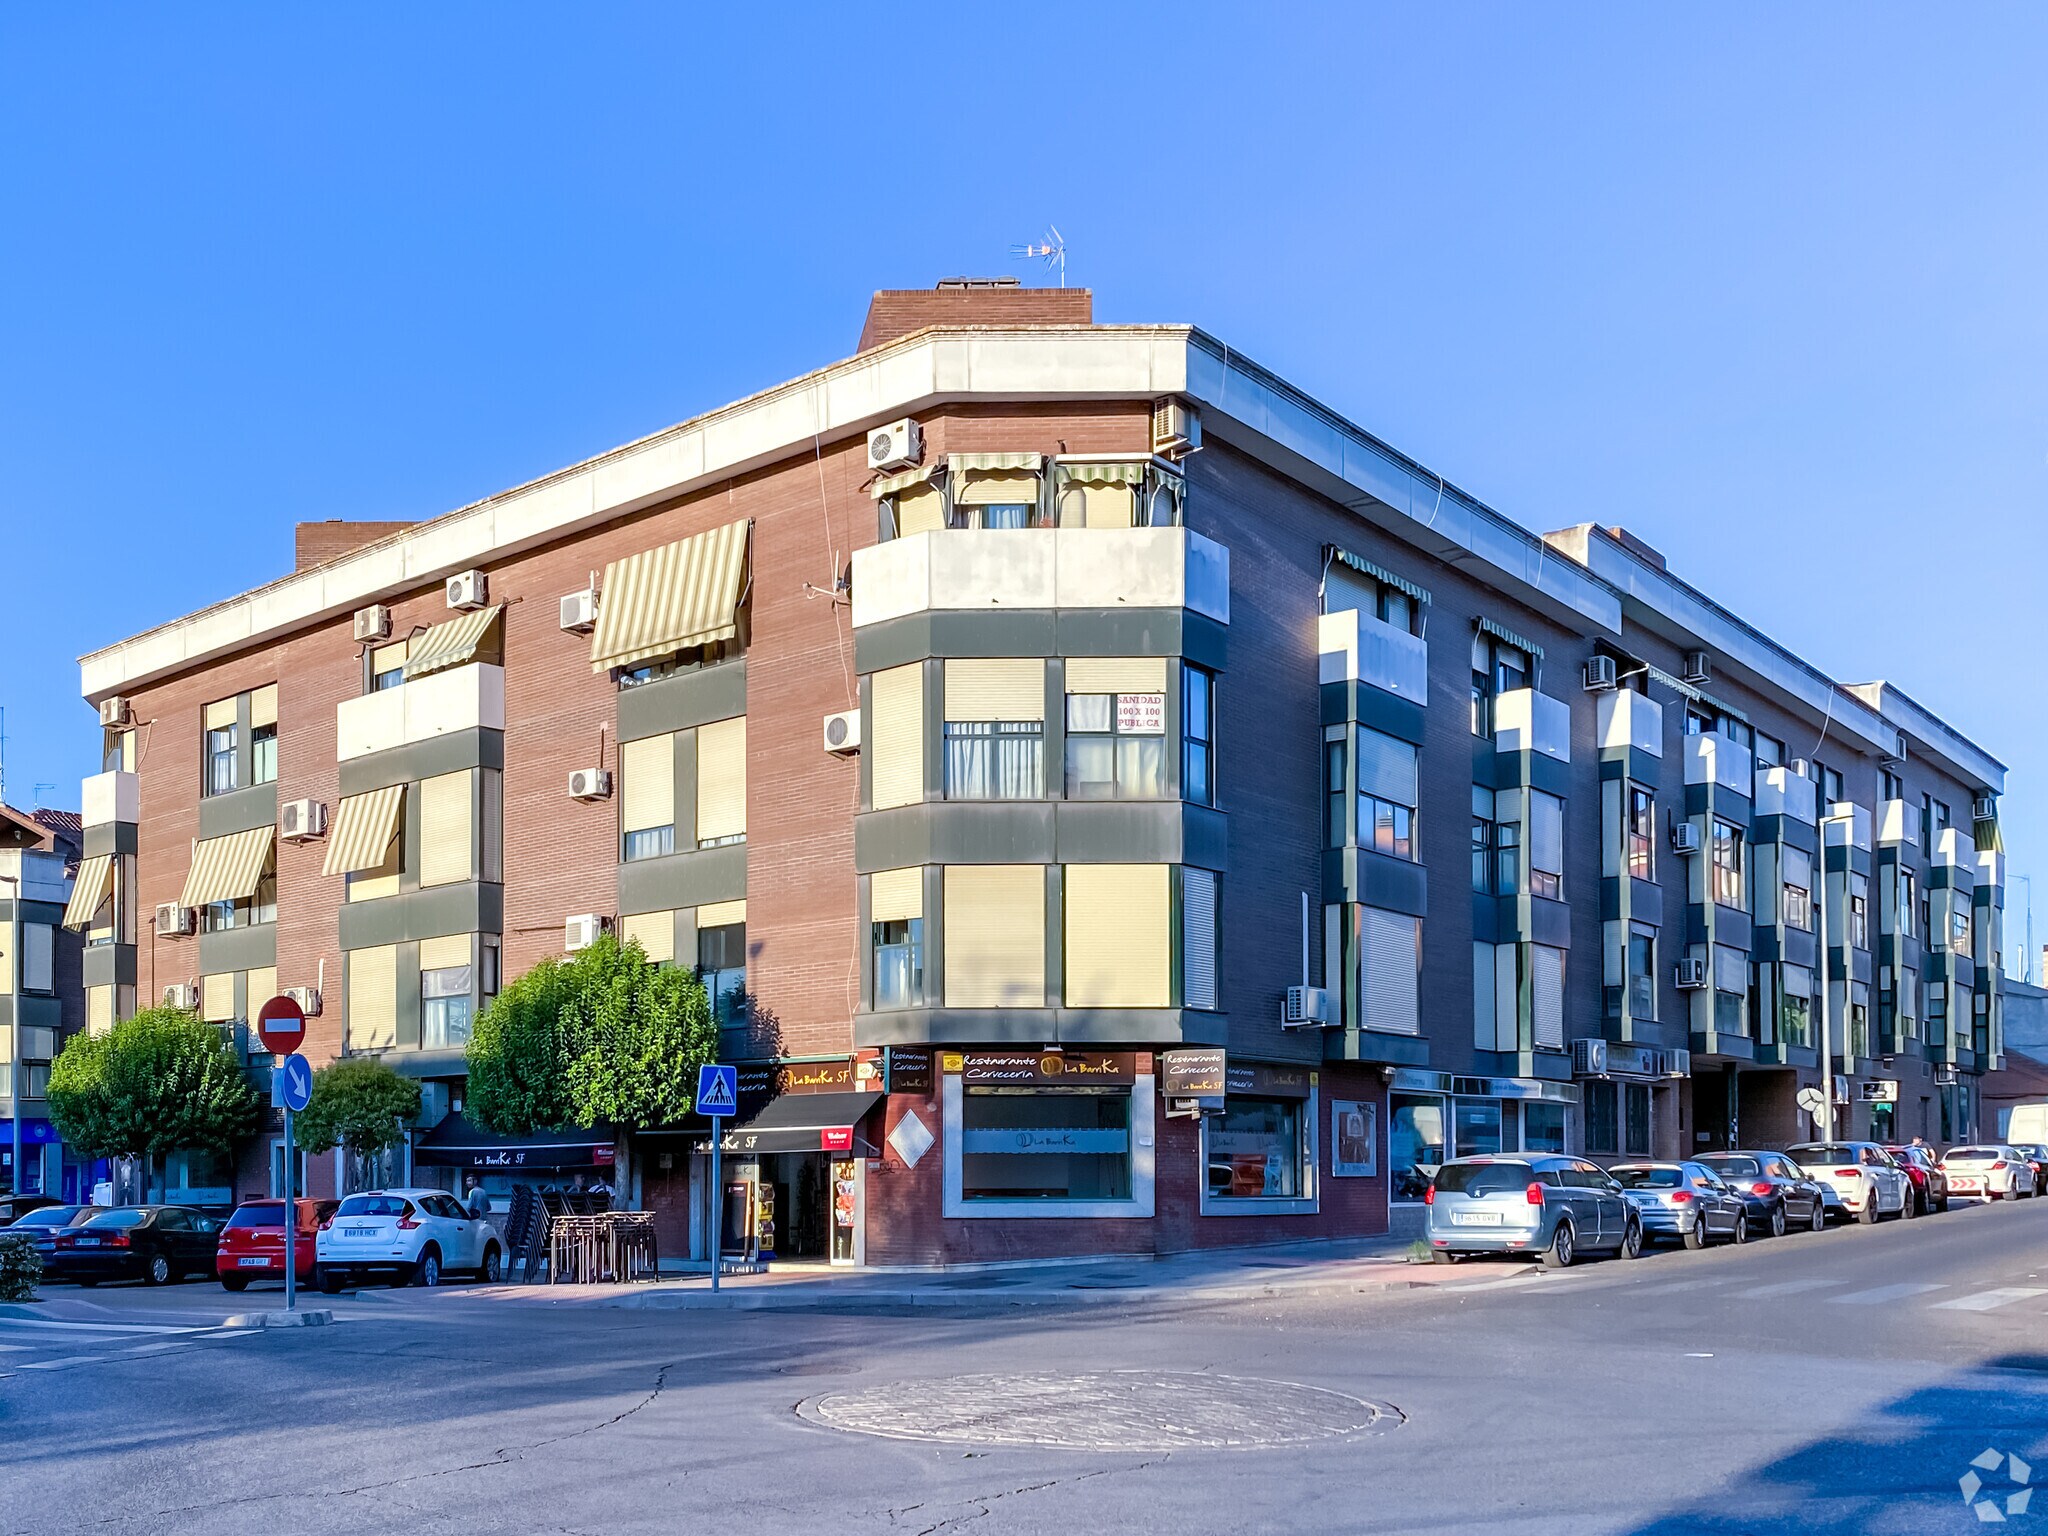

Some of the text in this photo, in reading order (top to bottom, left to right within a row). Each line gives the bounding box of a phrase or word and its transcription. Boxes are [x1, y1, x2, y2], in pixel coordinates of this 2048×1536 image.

[1117, 696, 1161, 704] SANIDAD
[1145, 707, 1161, 716] 100
[963, 1054, 1038, 1066] Restaurante
[1167, 1054, 1222, 1064] Restaurante
[1064, 1063, 1078, 1074] La
[793, 1075, 804, 1086] La
[836, 1070, 850, 1084] SF
[1213, 1081, 1224, 1090] SF
[745, 1135, 759, 1149] SF
[474, 1156, 483, 1165] La
[515, 1153, 526, 1164] SF
